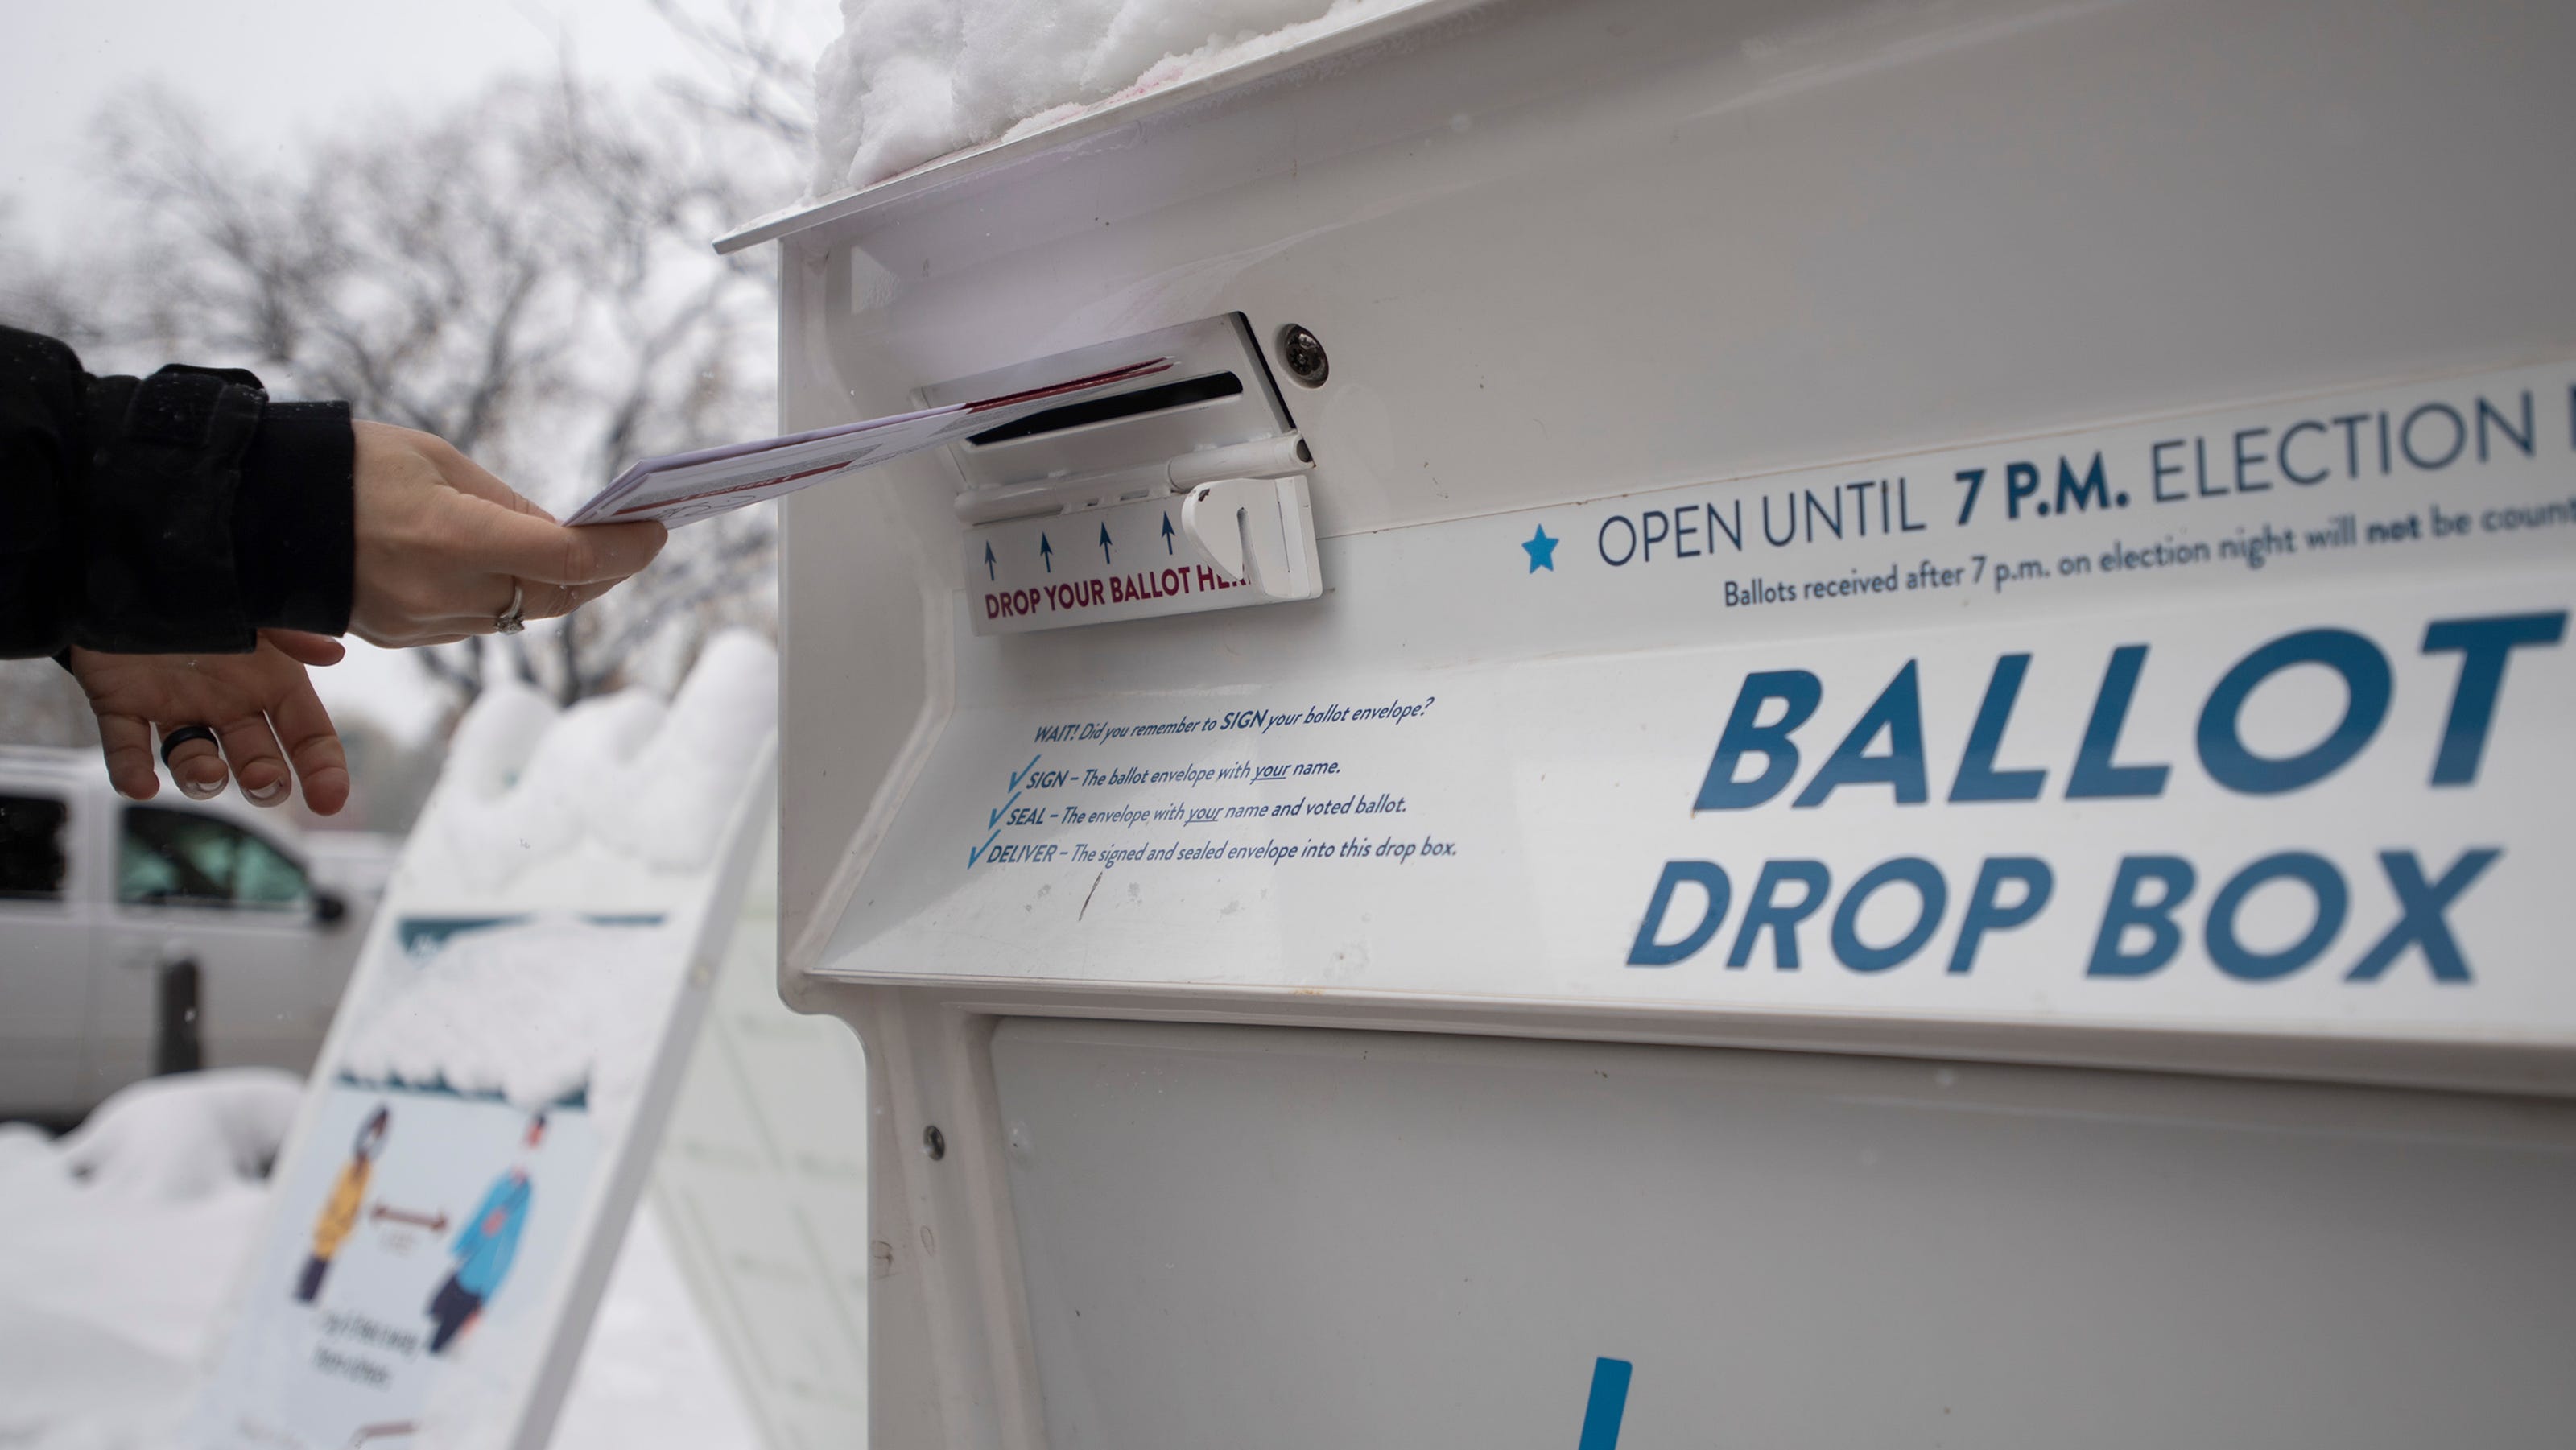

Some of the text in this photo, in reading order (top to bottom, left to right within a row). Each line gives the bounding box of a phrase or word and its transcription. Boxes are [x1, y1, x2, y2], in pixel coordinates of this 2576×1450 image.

[1598, 498, 1742, 567] OPEN
[1763, 477, 1926, 547] UNTIL
[1954, 469, 1987, 526] 7
[2004, 451, 2130, 520] P.M.
[2151, 390, 2537, 503] ELECTION
[1724, 578, 1797, 607] Ballots
[1804, 563, 1899, 599] received
[1905, 560, 1964, 589] after
[1970, 554, 1988, 584] 7
[1995, 559, 2050, 594] p.m.
[2058, 553, 2091, 576] on
[2098, 539, 2211, 573] election
[2219, 523, 2297, 571] night
[2306, 514, 2357, 550] will
[2366, 514, 2422, 545] not
[2429, 503, 2471, 538] be
[985, 588, 1041, 620] DROP
[1043, 579, 1106, 612] YOUR
[1109, 566, 1191, 603] BALLOT
[1034, 696, 1435, 746] WAIT! Did you remember to SIGN your ballot envelope?
[1692, 610, 2570, 810] BALLOT
[1026, 770, 1070, 790] SIGN
[1081, 768, 1106, 787] The
[1108, 766, 1149, 787] ballot
[1150, 763, 1215, 788] envelope
[1217, 760, 1250, 781] with
[1249, 763, 1291, 786] your
[1292, 762, 1341, 776] name.
[1006, 807, 1046, 826] SEAL
[1061, 806, 1086, 824] The
[1088, 804, 1151, 829] envelope
[1153, 802, 1185, 822] with
[1183, 806, 1224, 828] your
[1224, 806, 1269, 819] name
[1271, 796, 1306, 817] and
[1306, 795, 1356, 816] voted
[1354, 793, 1407, 814] ballot.
[986, 845, 1058, 864] DELIVER
[1071, 844, 1096, 863] The
[1098, 841, 1150, 869] signed
[1146, 841, 1179, 861] and
[1177, 840, 1229, 861] sealed
[1227, 838, 1298, 866] envelope
[1300, 838, 1335, 858] into
[1338, 837, 1370, 857] this
[1375, 836, 1416, 865] drop
[1420, 835, 1458, 857] box.
[1626, 847, 2507, 985] DROP BOX
